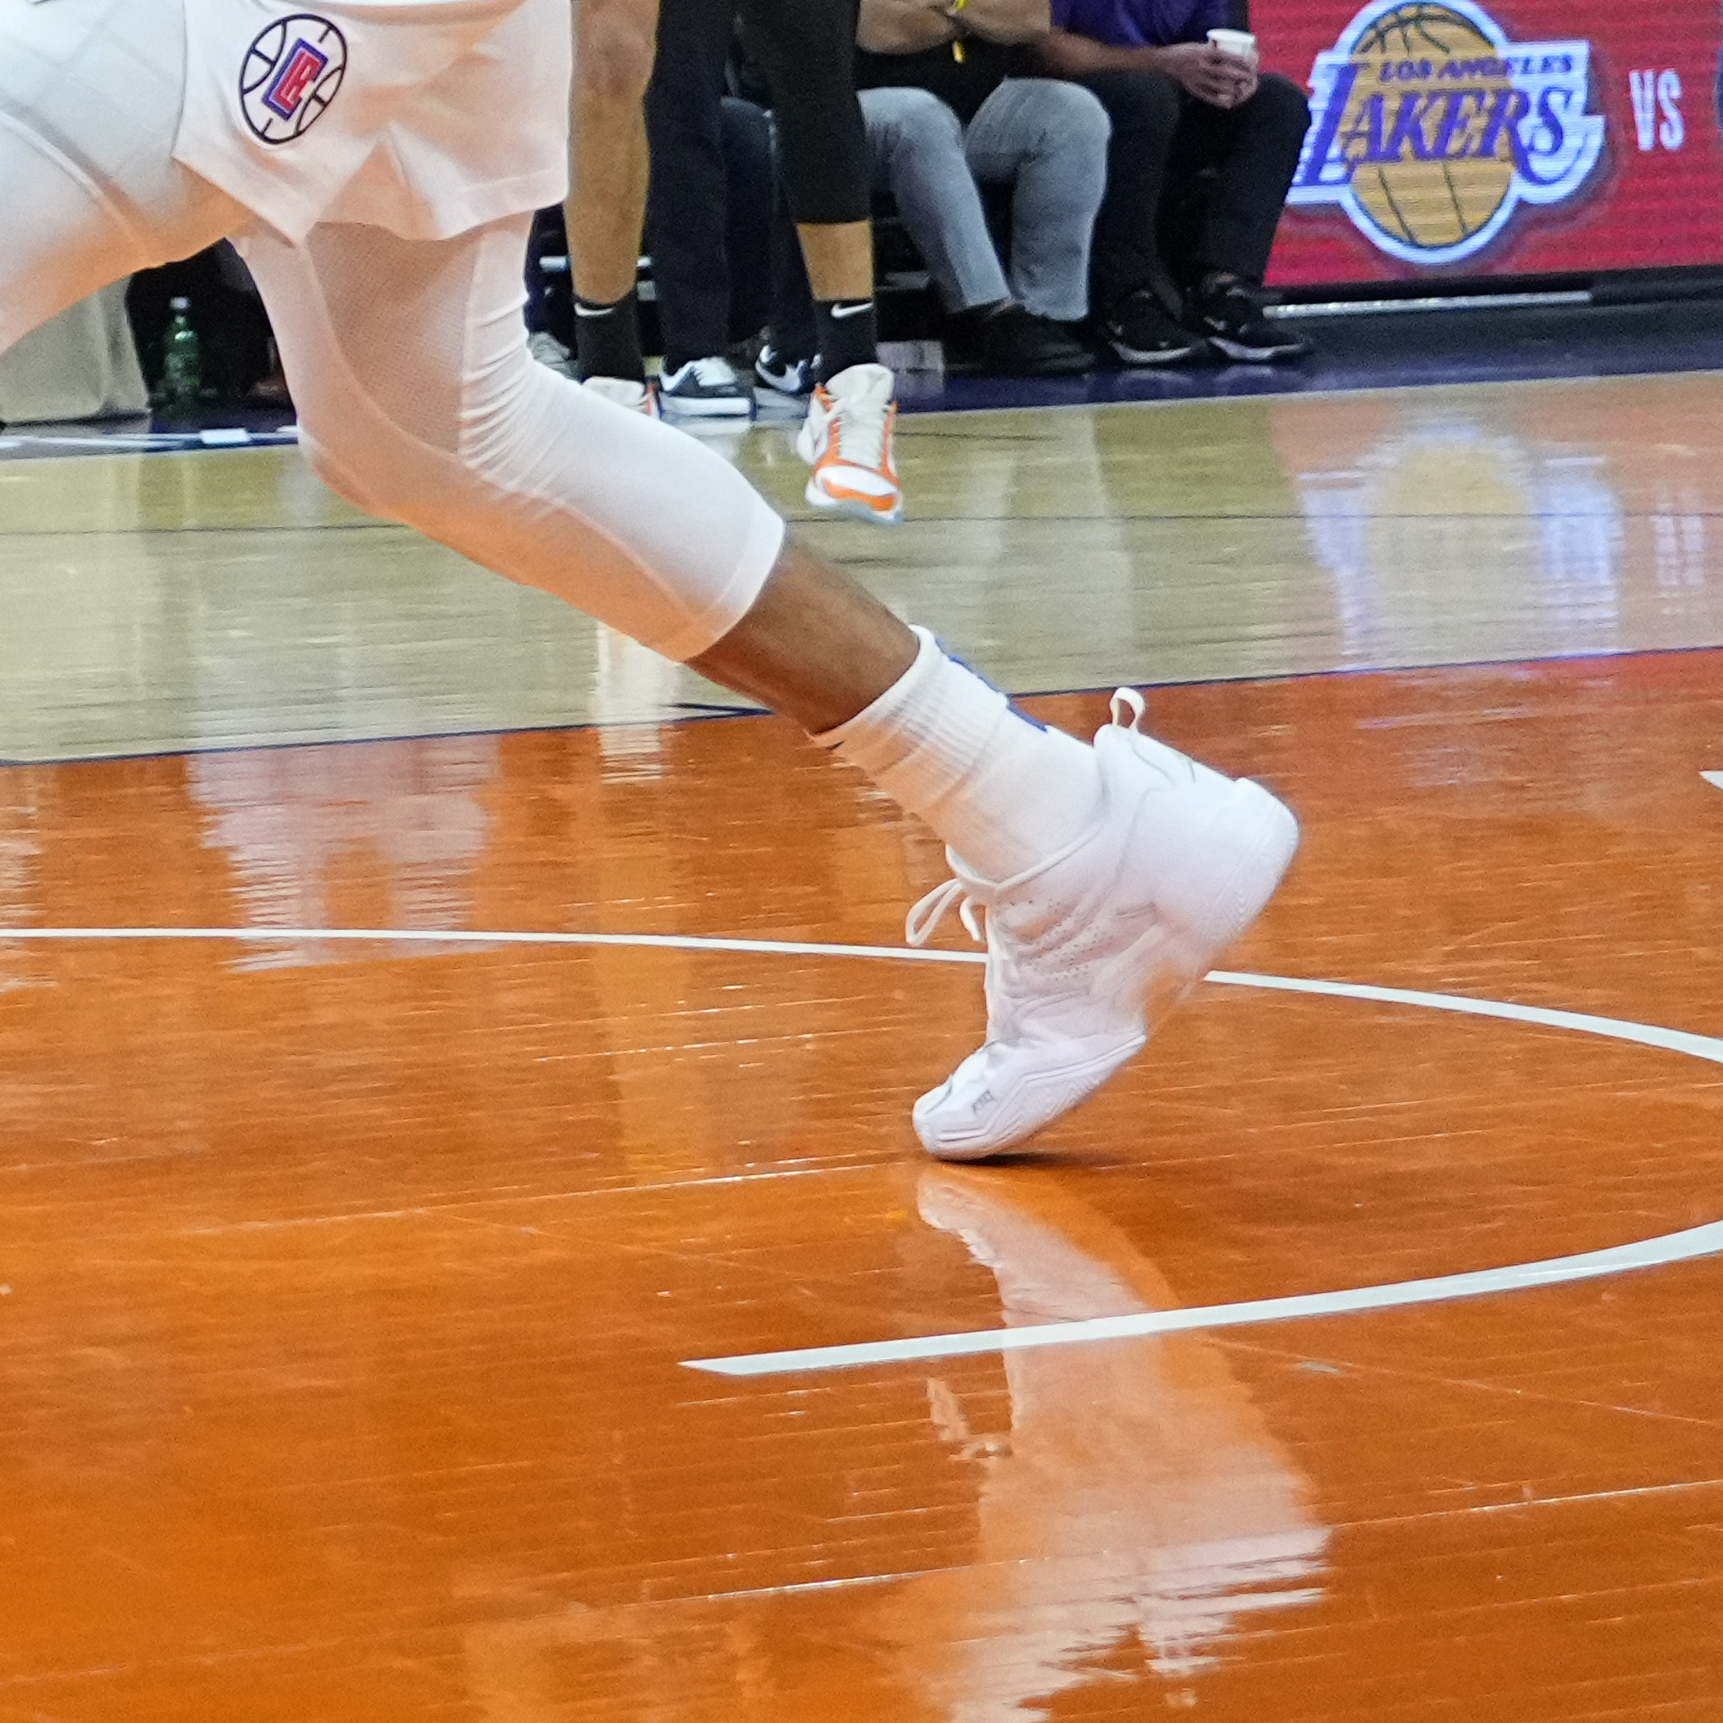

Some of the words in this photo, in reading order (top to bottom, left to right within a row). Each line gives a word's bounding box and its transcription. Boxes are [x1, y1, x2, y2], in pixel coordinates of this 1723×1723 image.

[1379, 59, 1433, 83] LOS
[1437, 54, 1574, 80] ANGELES
[1629, 68, 1686, 151] VS
[1303, 62, 1575, 187] LAKERS
